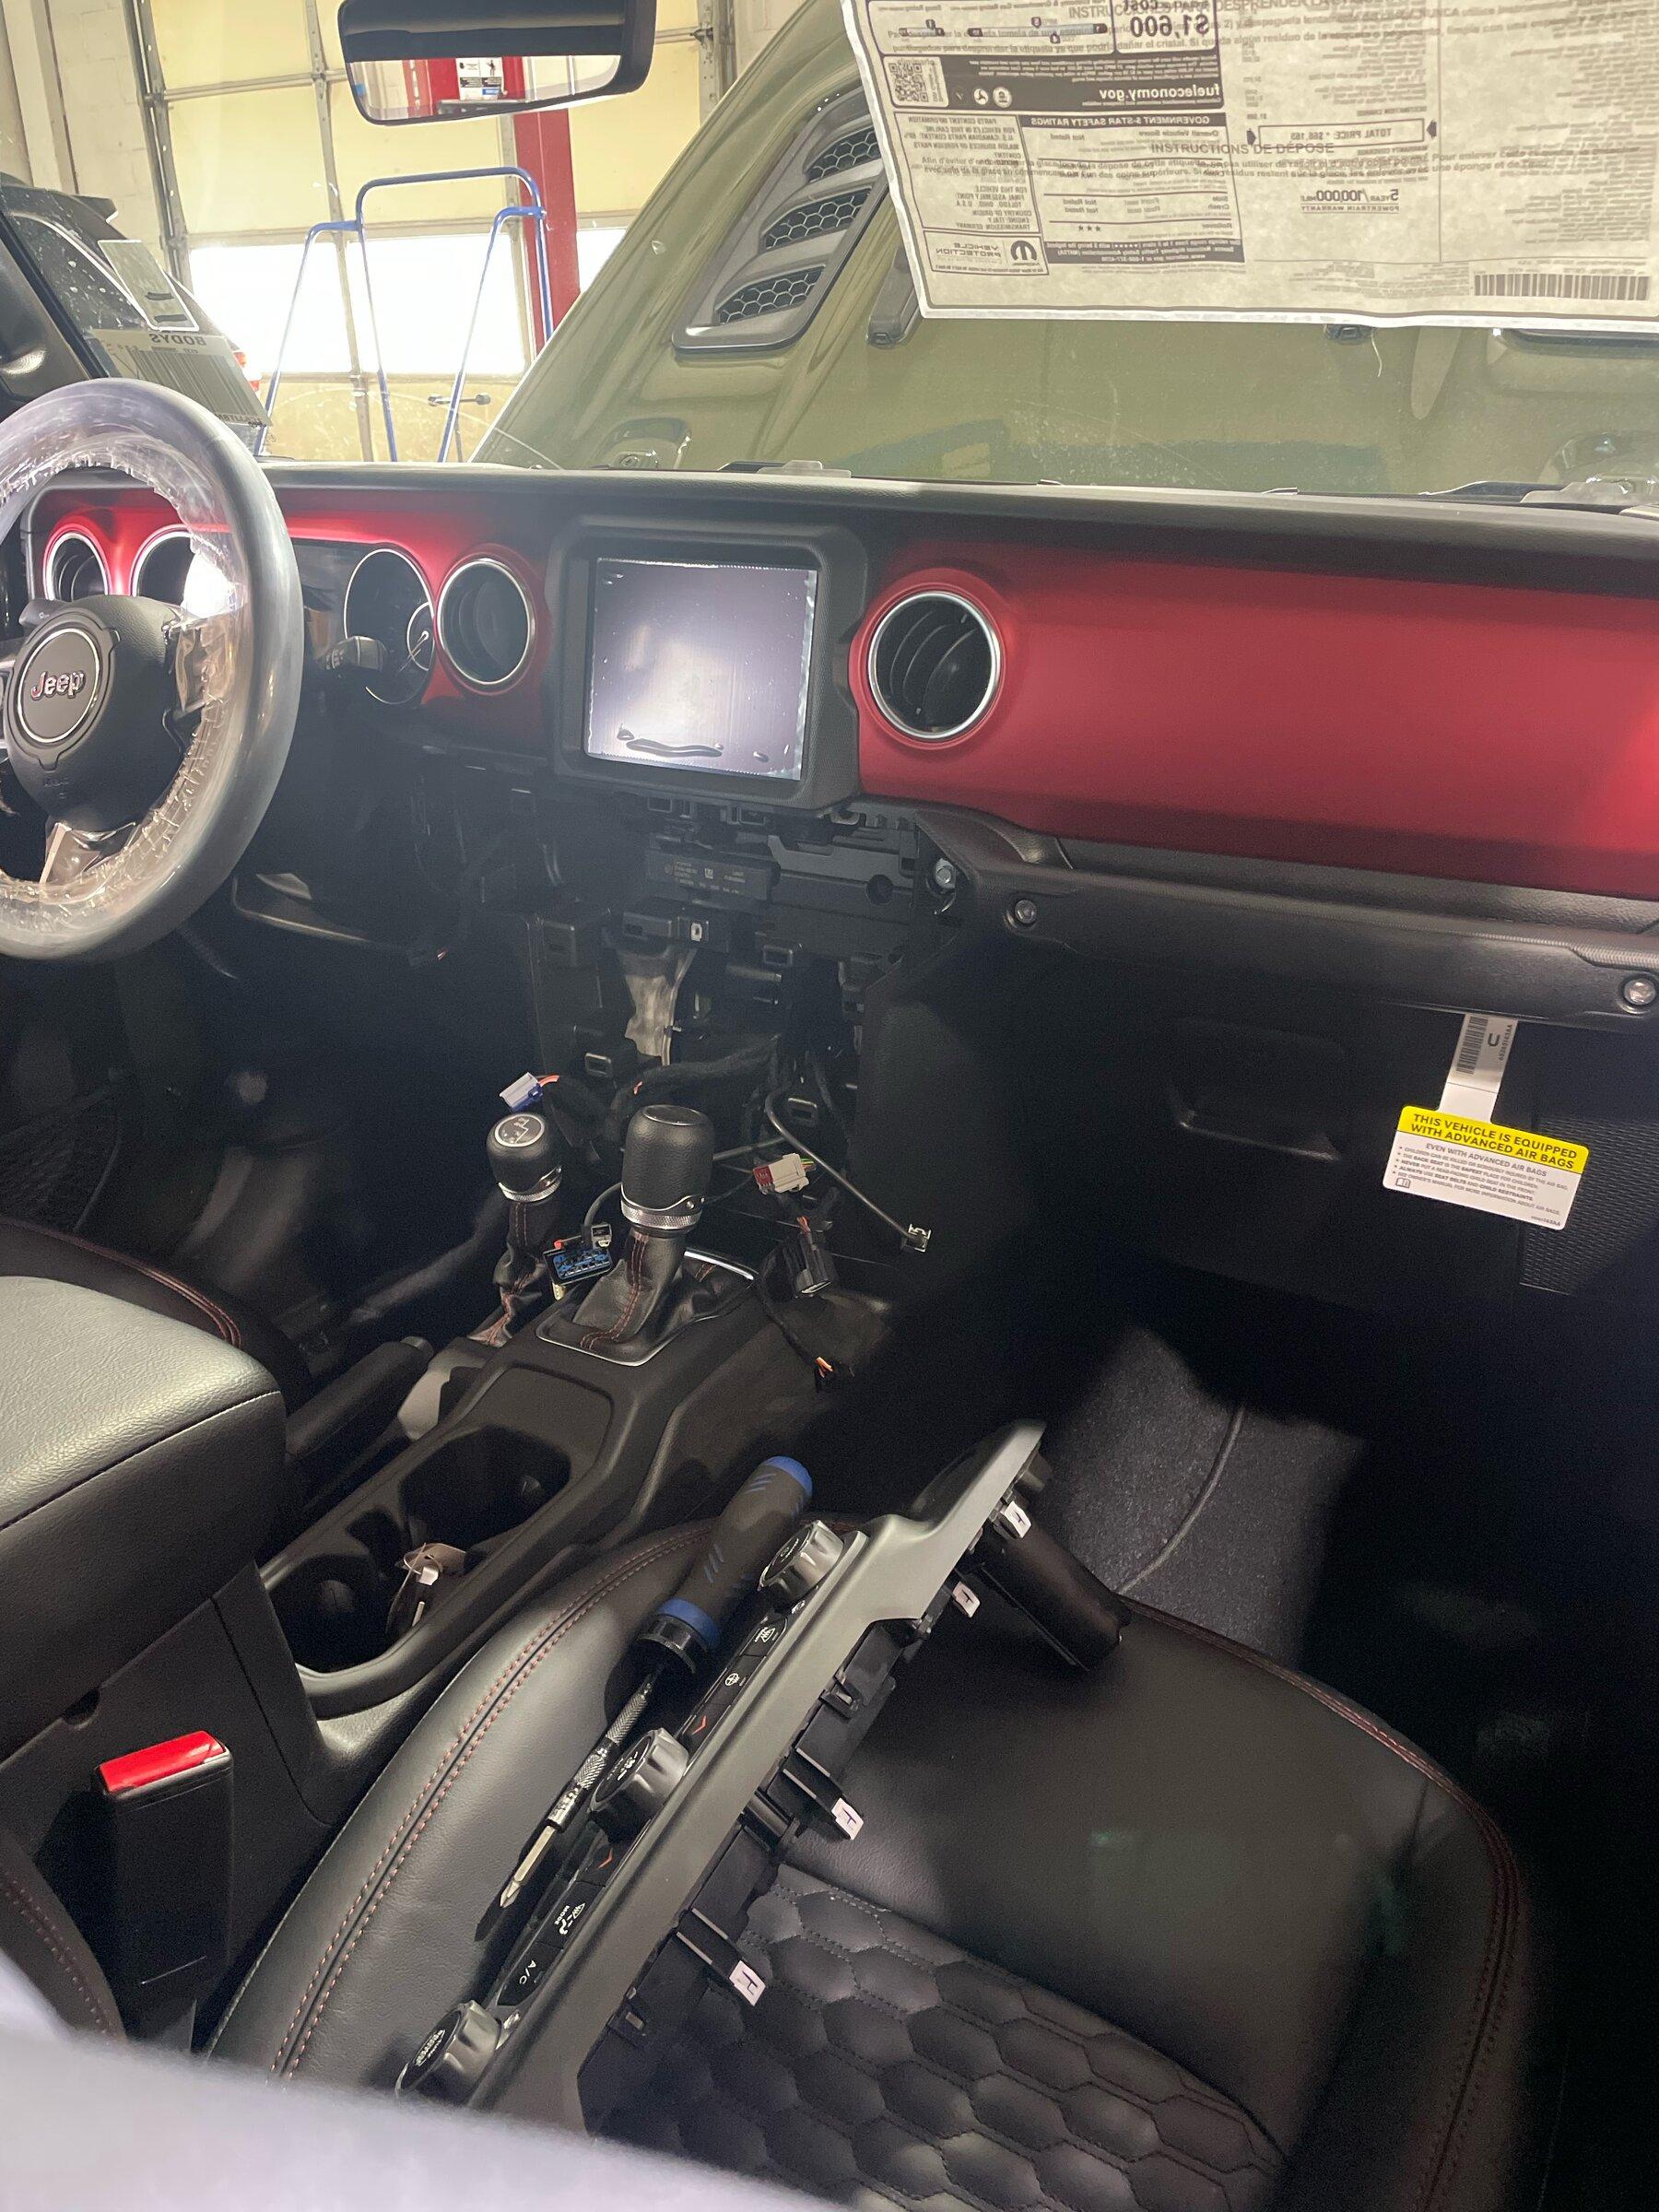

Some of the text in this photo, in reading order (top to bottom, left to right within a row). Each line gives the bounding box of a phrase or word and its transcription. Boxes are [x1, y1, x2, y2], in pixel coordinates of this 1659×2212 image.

[1151, 143, 1249, 155] INSTRUCTIONS
[1253, 143, 1273, 155] DE
[30, 670, 86, 700] Jeep
[1410, 1123, 1574, 1169] WITH ADVANCED AIR BAGS
[1413, 1113, 1577, 1159] THIS VEHICLE IS EQUIPPED
[1399, 1165, 1422, 1175] ALWAYS
[1426, 1143, 1547, 1177] EVEN WITH ADVANCED AIR BAGS
[554, 1905, 571, 1925] MODE
[519, 1959, 536, 1985] A/C
